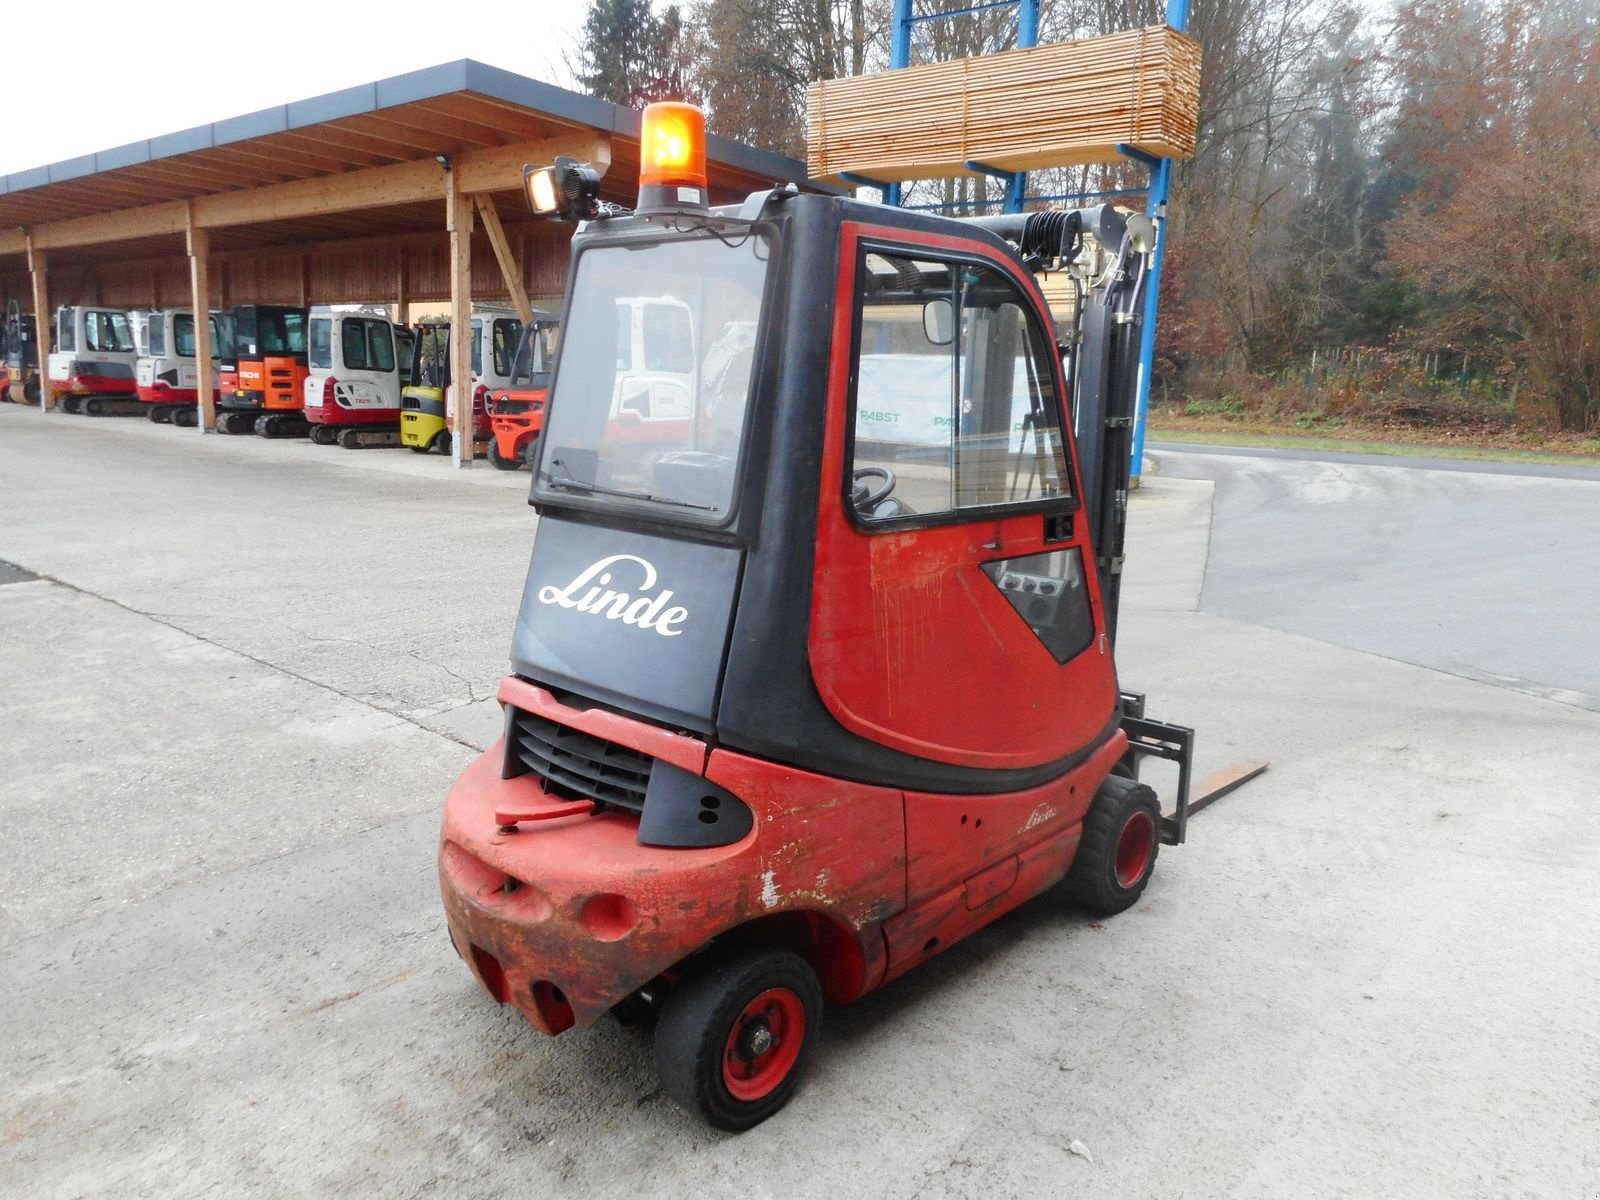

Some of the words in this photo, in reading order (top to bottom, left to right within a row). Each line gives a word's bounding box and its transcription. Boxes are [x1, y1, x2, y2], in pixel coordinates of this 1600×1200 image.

[860, 409, 901, 423] PABST
[934, 416, 954, 428] PA
[538, 554, 689, 636] Linde
[1017, 802, 1057, 834] Linde
